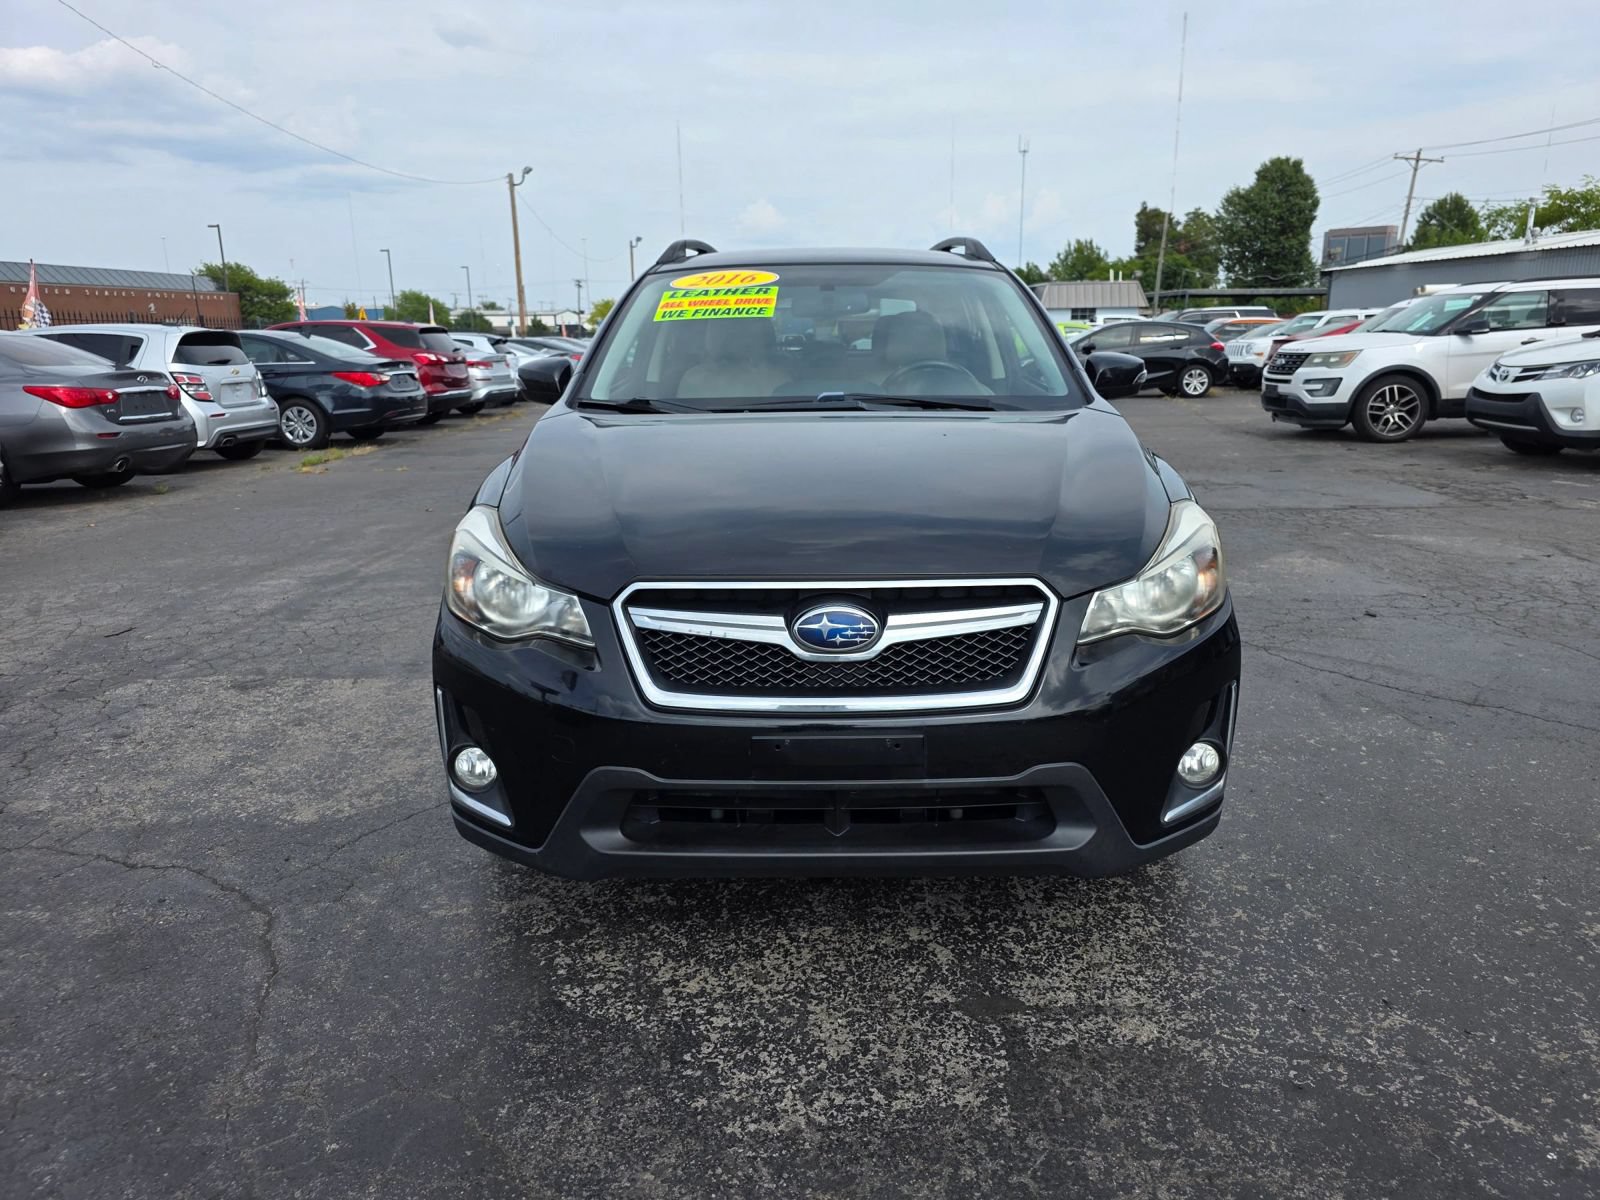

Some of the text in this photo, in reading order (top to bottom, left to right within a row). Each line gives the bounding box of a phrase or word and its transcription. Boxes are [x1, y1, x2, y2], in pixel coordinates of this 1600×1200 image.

[688, 274, 758, 287] 2016
[668, 287, 771, 298] LEATHER
[688, 298, 732, 307] WHEEL
[734, 297, 775, 305] DRIVE
[661, 307, 768, 319] WE FINANCE
